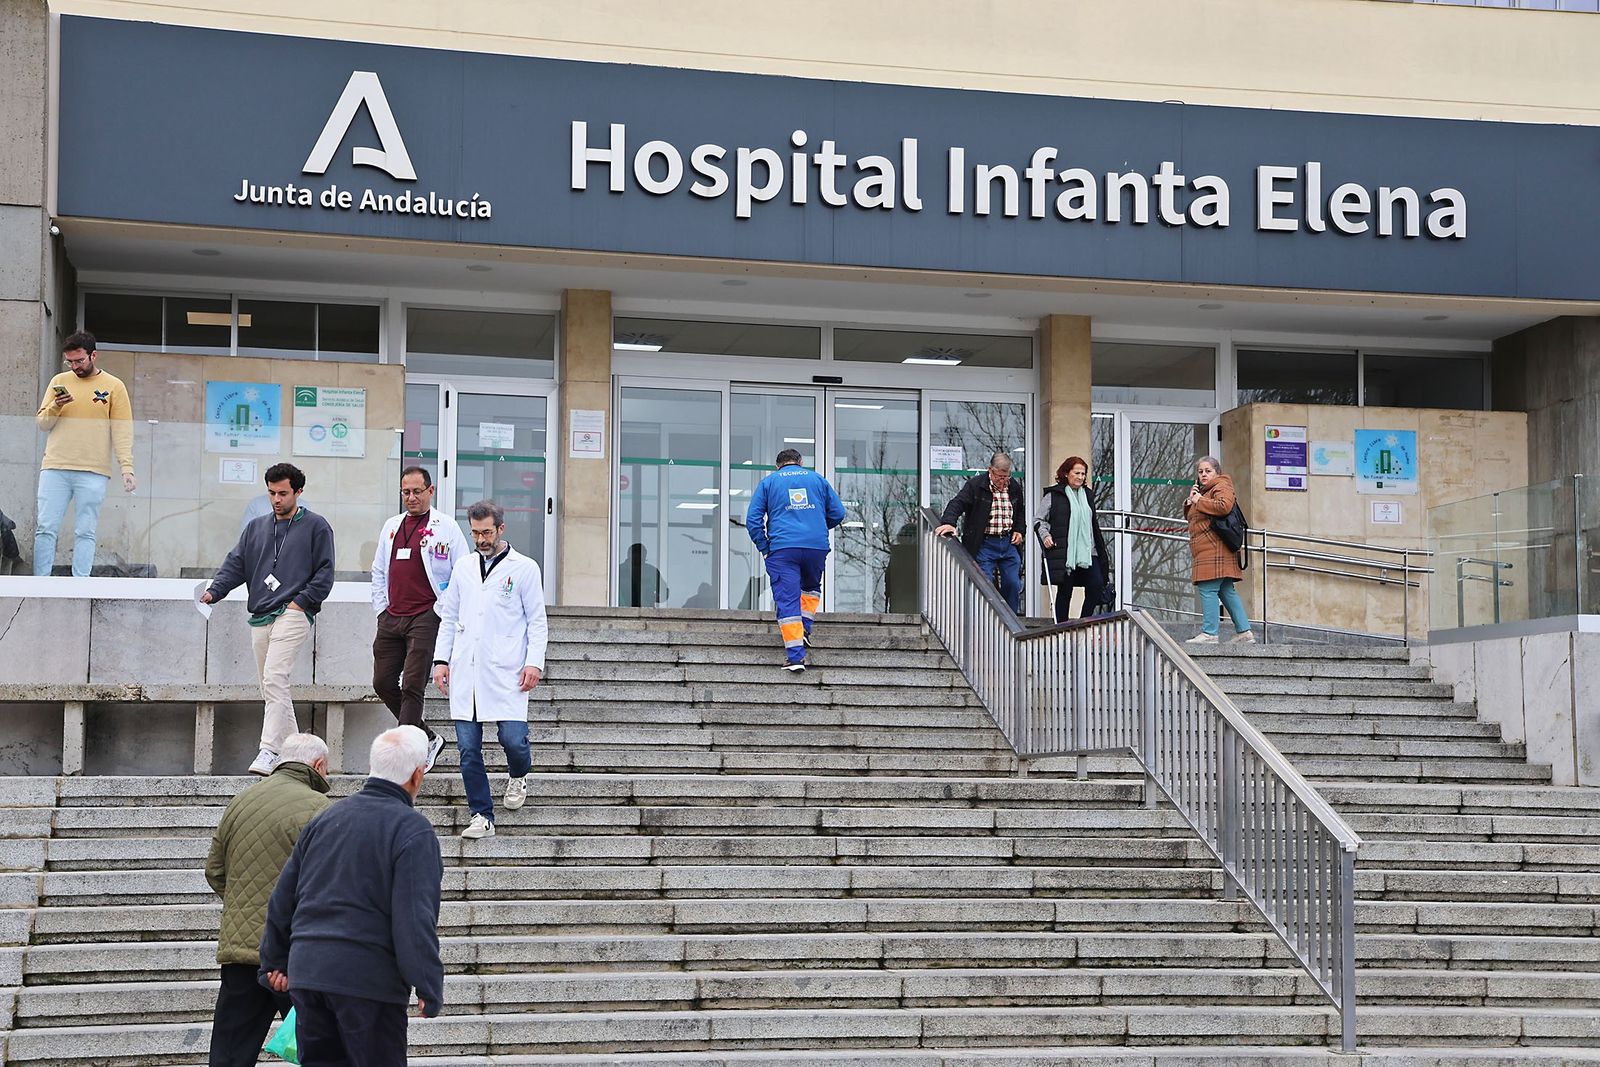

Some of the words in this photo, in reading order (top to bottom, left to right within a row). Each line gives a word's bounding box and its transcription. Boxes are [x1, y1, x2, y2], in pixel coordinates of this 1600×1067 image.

[234, 180, 313, 206] Junta
[321, 185, 353, 208] de
[360, 189, 492, 218] Andalucía
[571, 120, 923, 218] Hospital
[950, 147, 1230, 227] Infanta
[1258, 162, 1467, 238] Elena
